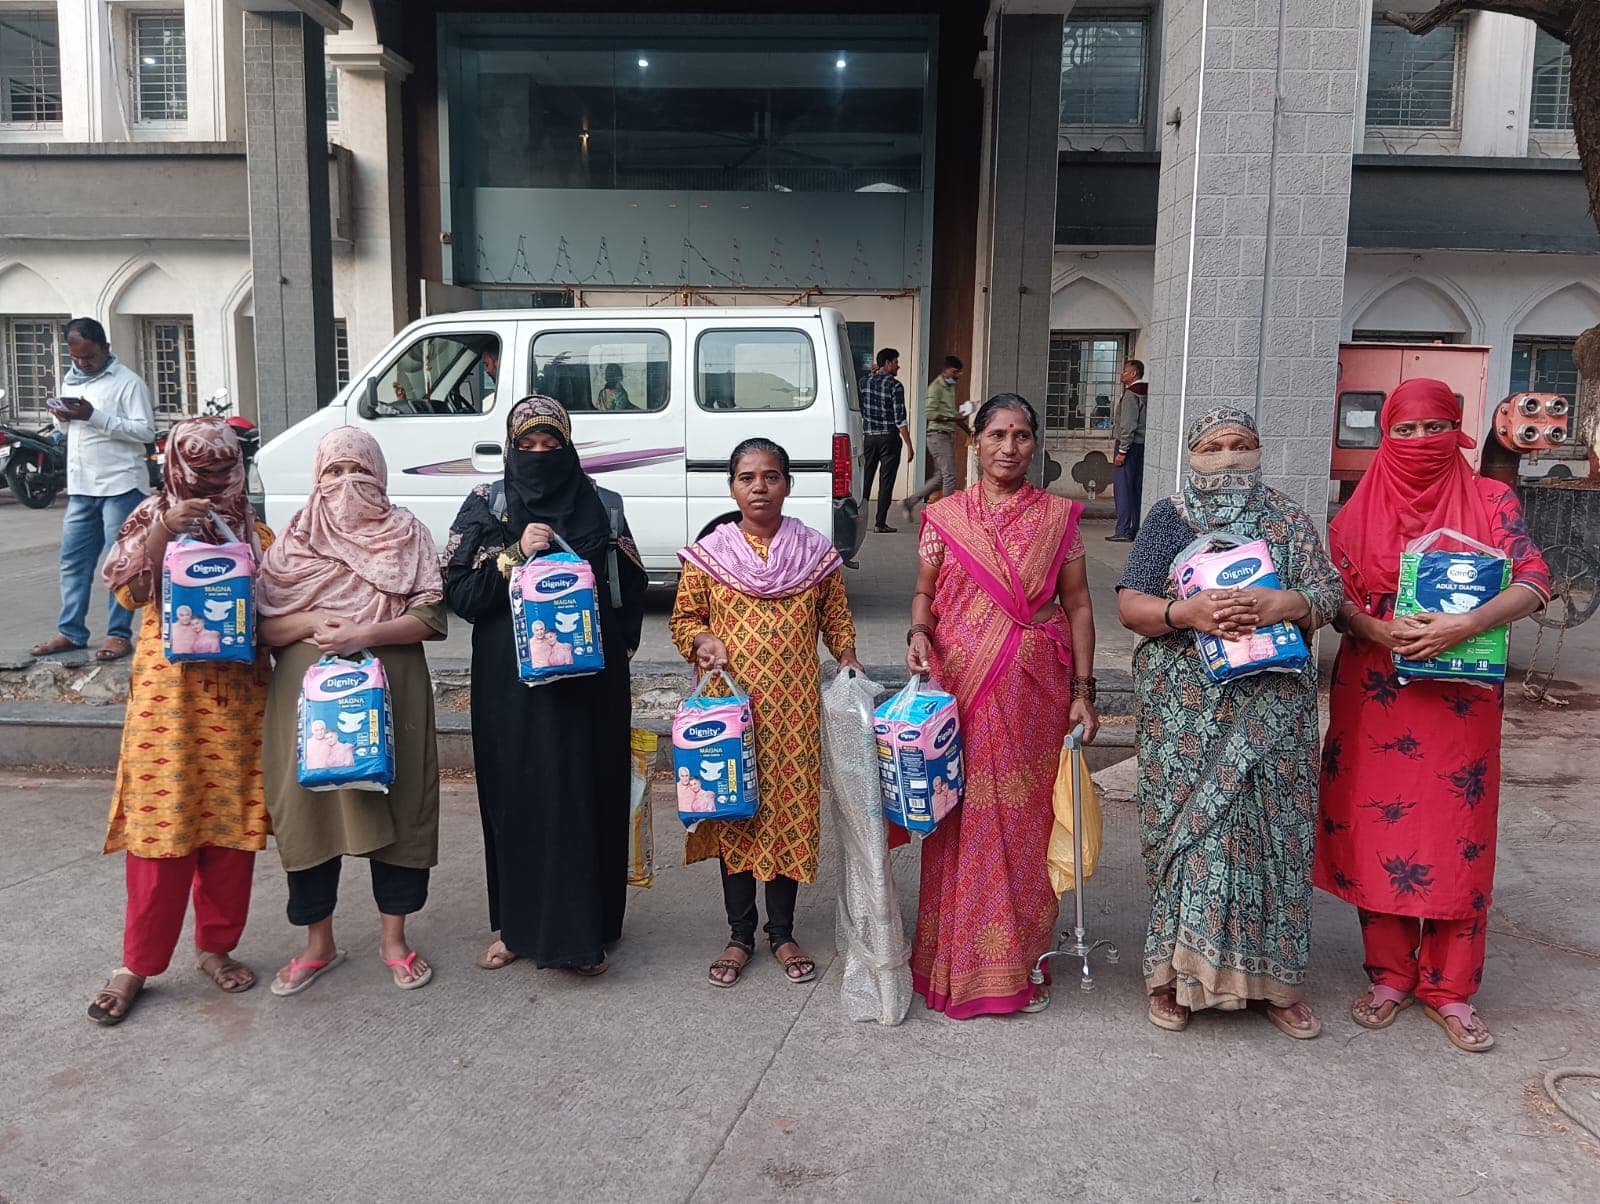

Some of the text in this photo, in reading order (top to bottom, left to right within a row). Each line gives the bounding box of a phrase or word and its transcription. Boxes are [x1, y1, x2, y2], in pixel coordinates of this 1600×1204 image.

[193, 564, 227, 575] Dignity
[1222, 565, 1255, 580] Dignity
[541, 580, 571, 589] Dignity
[1436, 583, 1486, 592] ADULT DIAPERS
[327, 678, 360, 689] Dignity
[689, 727, 719, 737] Dignity
[937, 724, 954, 743] Dignity
